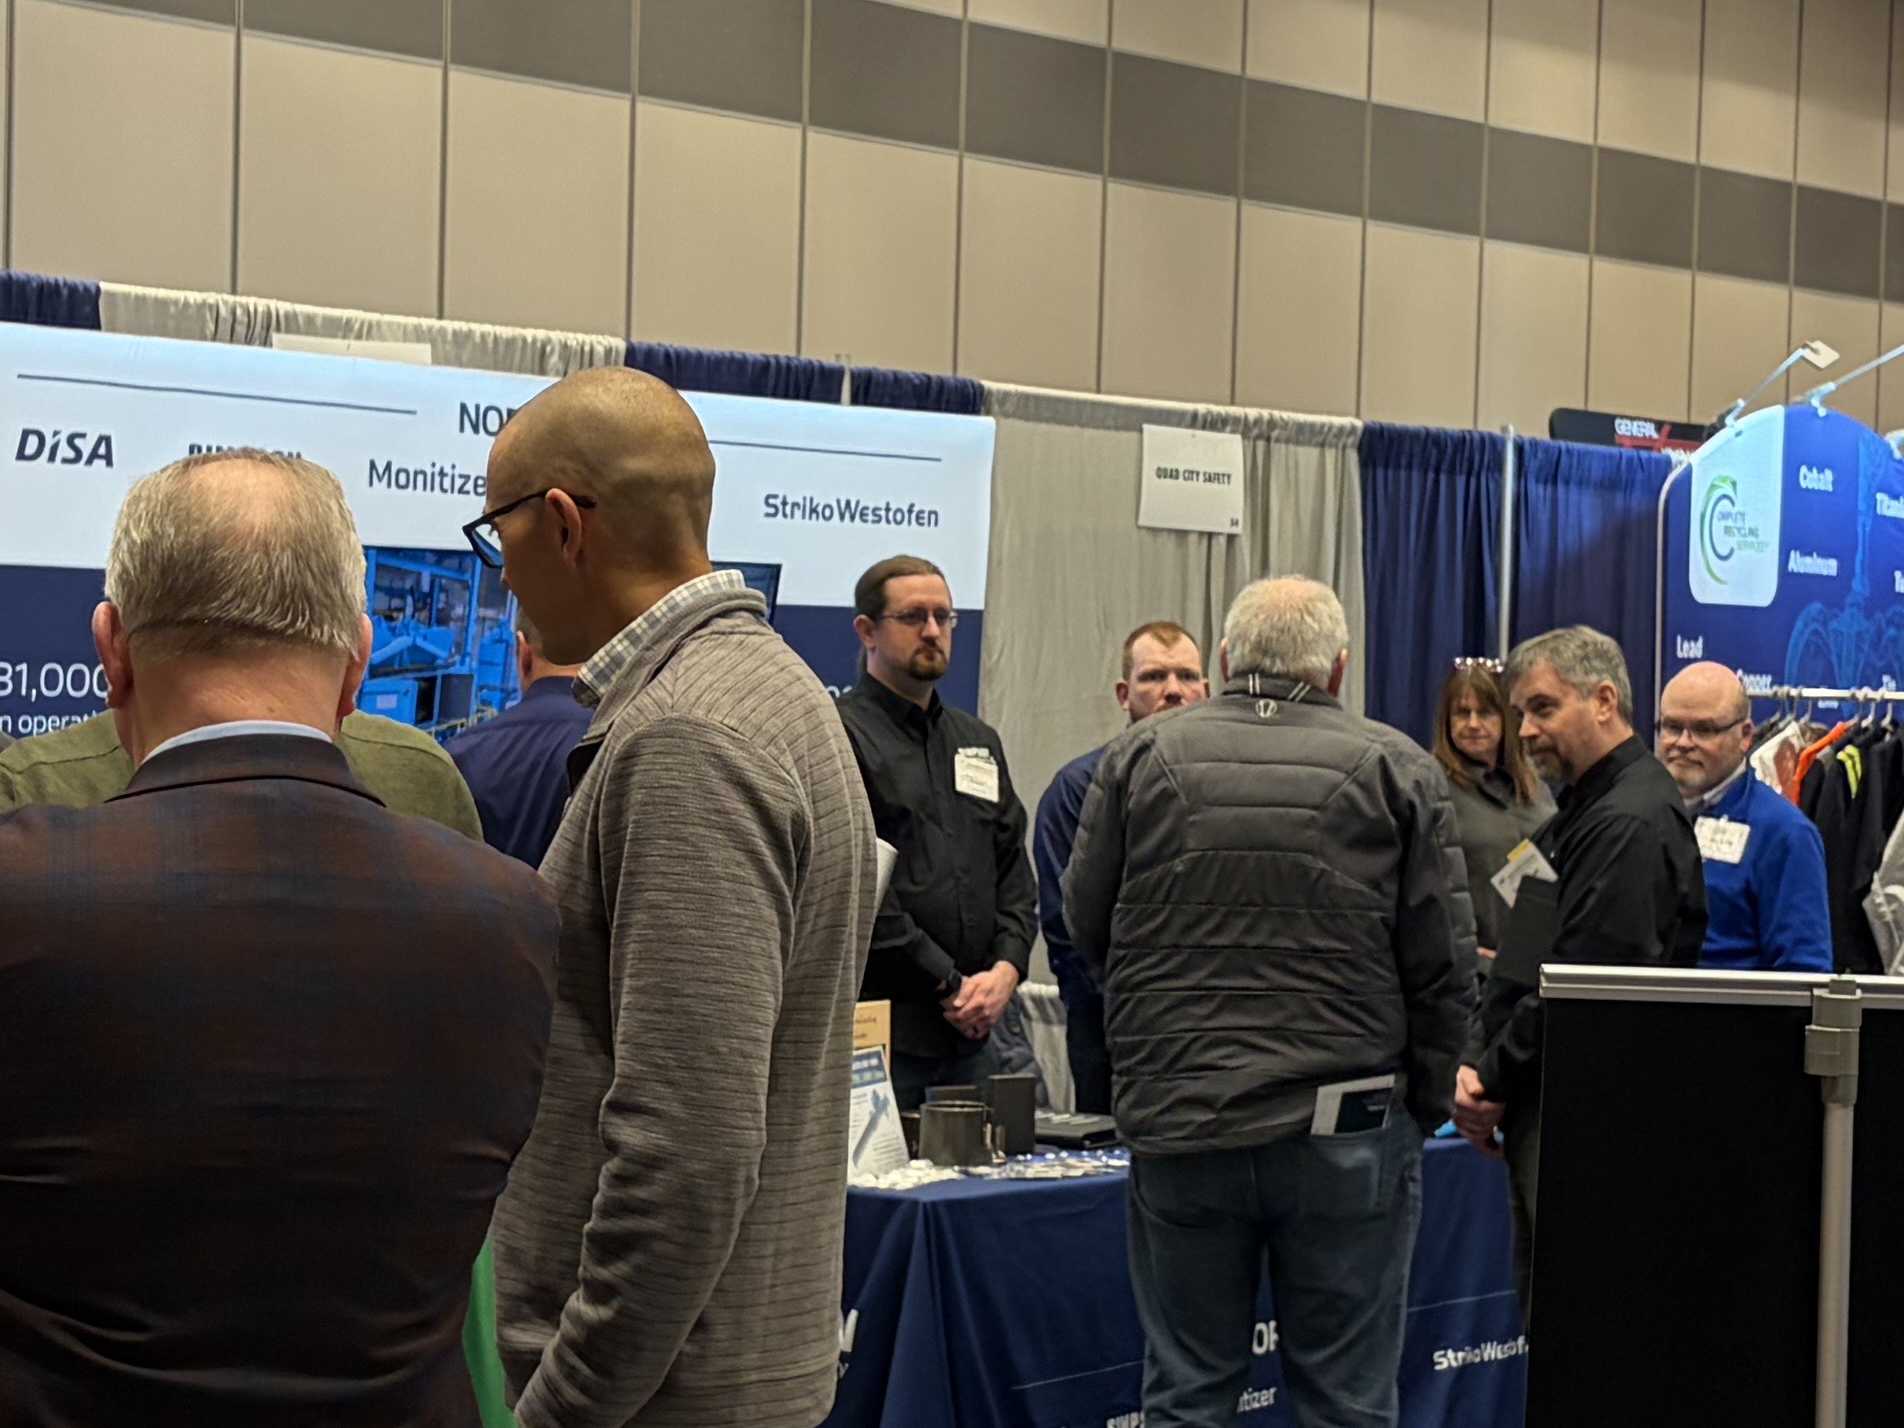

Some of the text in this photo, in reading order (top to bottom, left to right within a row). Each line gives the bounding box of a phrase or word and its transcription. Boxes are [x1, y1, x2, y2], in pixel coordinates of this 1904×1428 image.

[368, 458, 487, 497] Monitize
[1156, 466, 1232, 486] QUAD CITY SAFETY
[1799, 464, 1833, 492] Cobalt
[763, 493, 939, 528] StrikoWestofen
[1676, 634, 1703, 659] Lead
